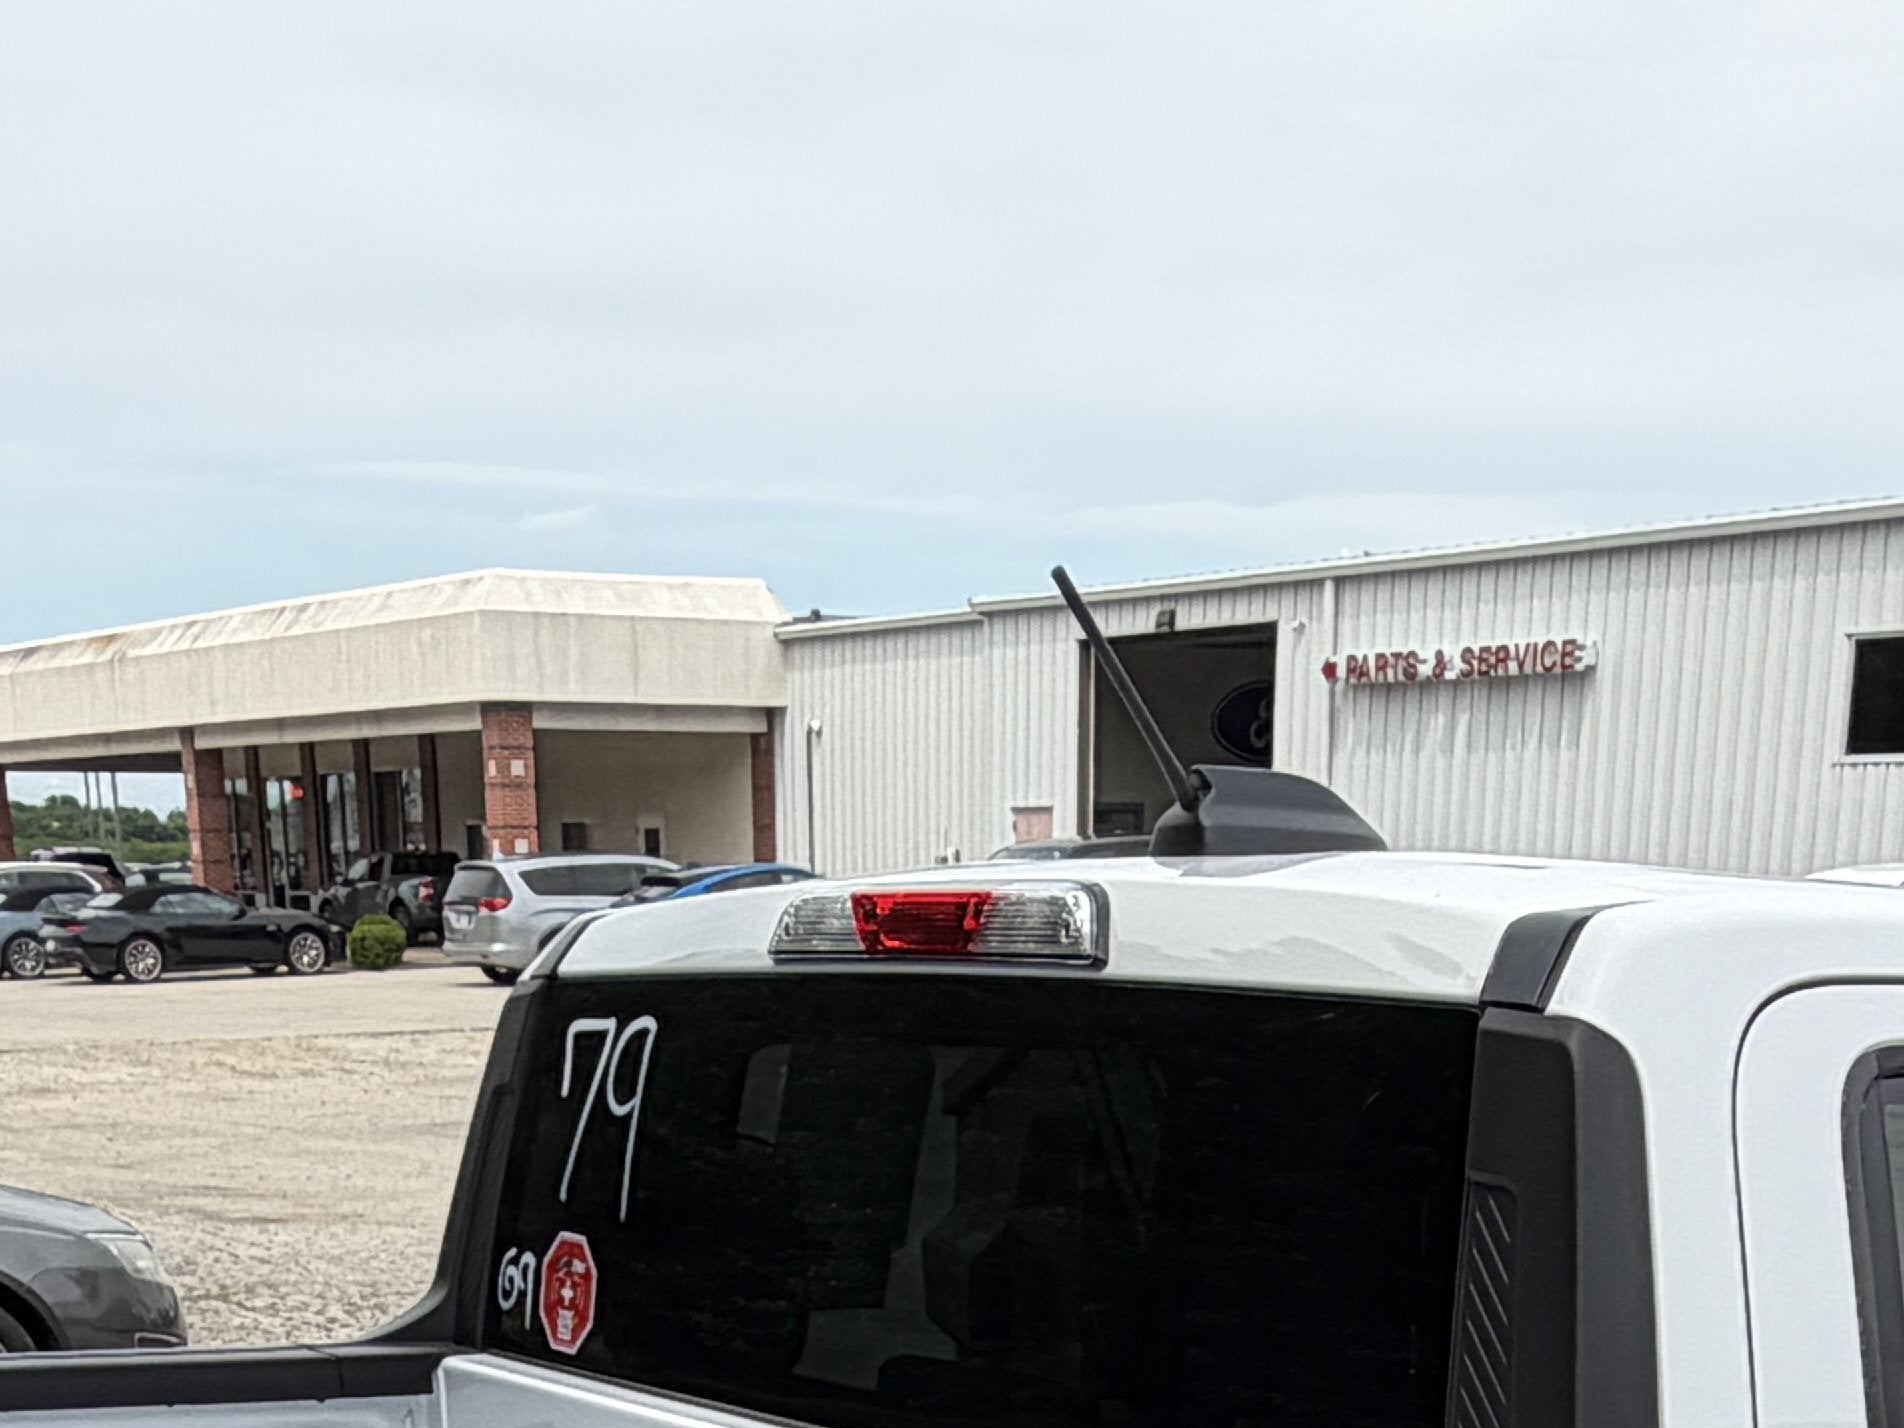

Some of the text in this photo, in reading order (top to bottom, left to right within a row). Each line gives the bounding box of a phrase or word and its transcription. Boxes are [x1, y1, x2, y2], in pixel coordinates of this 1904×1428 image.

[1346, 638, 1578, 683] PARTS & SERVICE
[561, 1015, 658, 1222] 79
